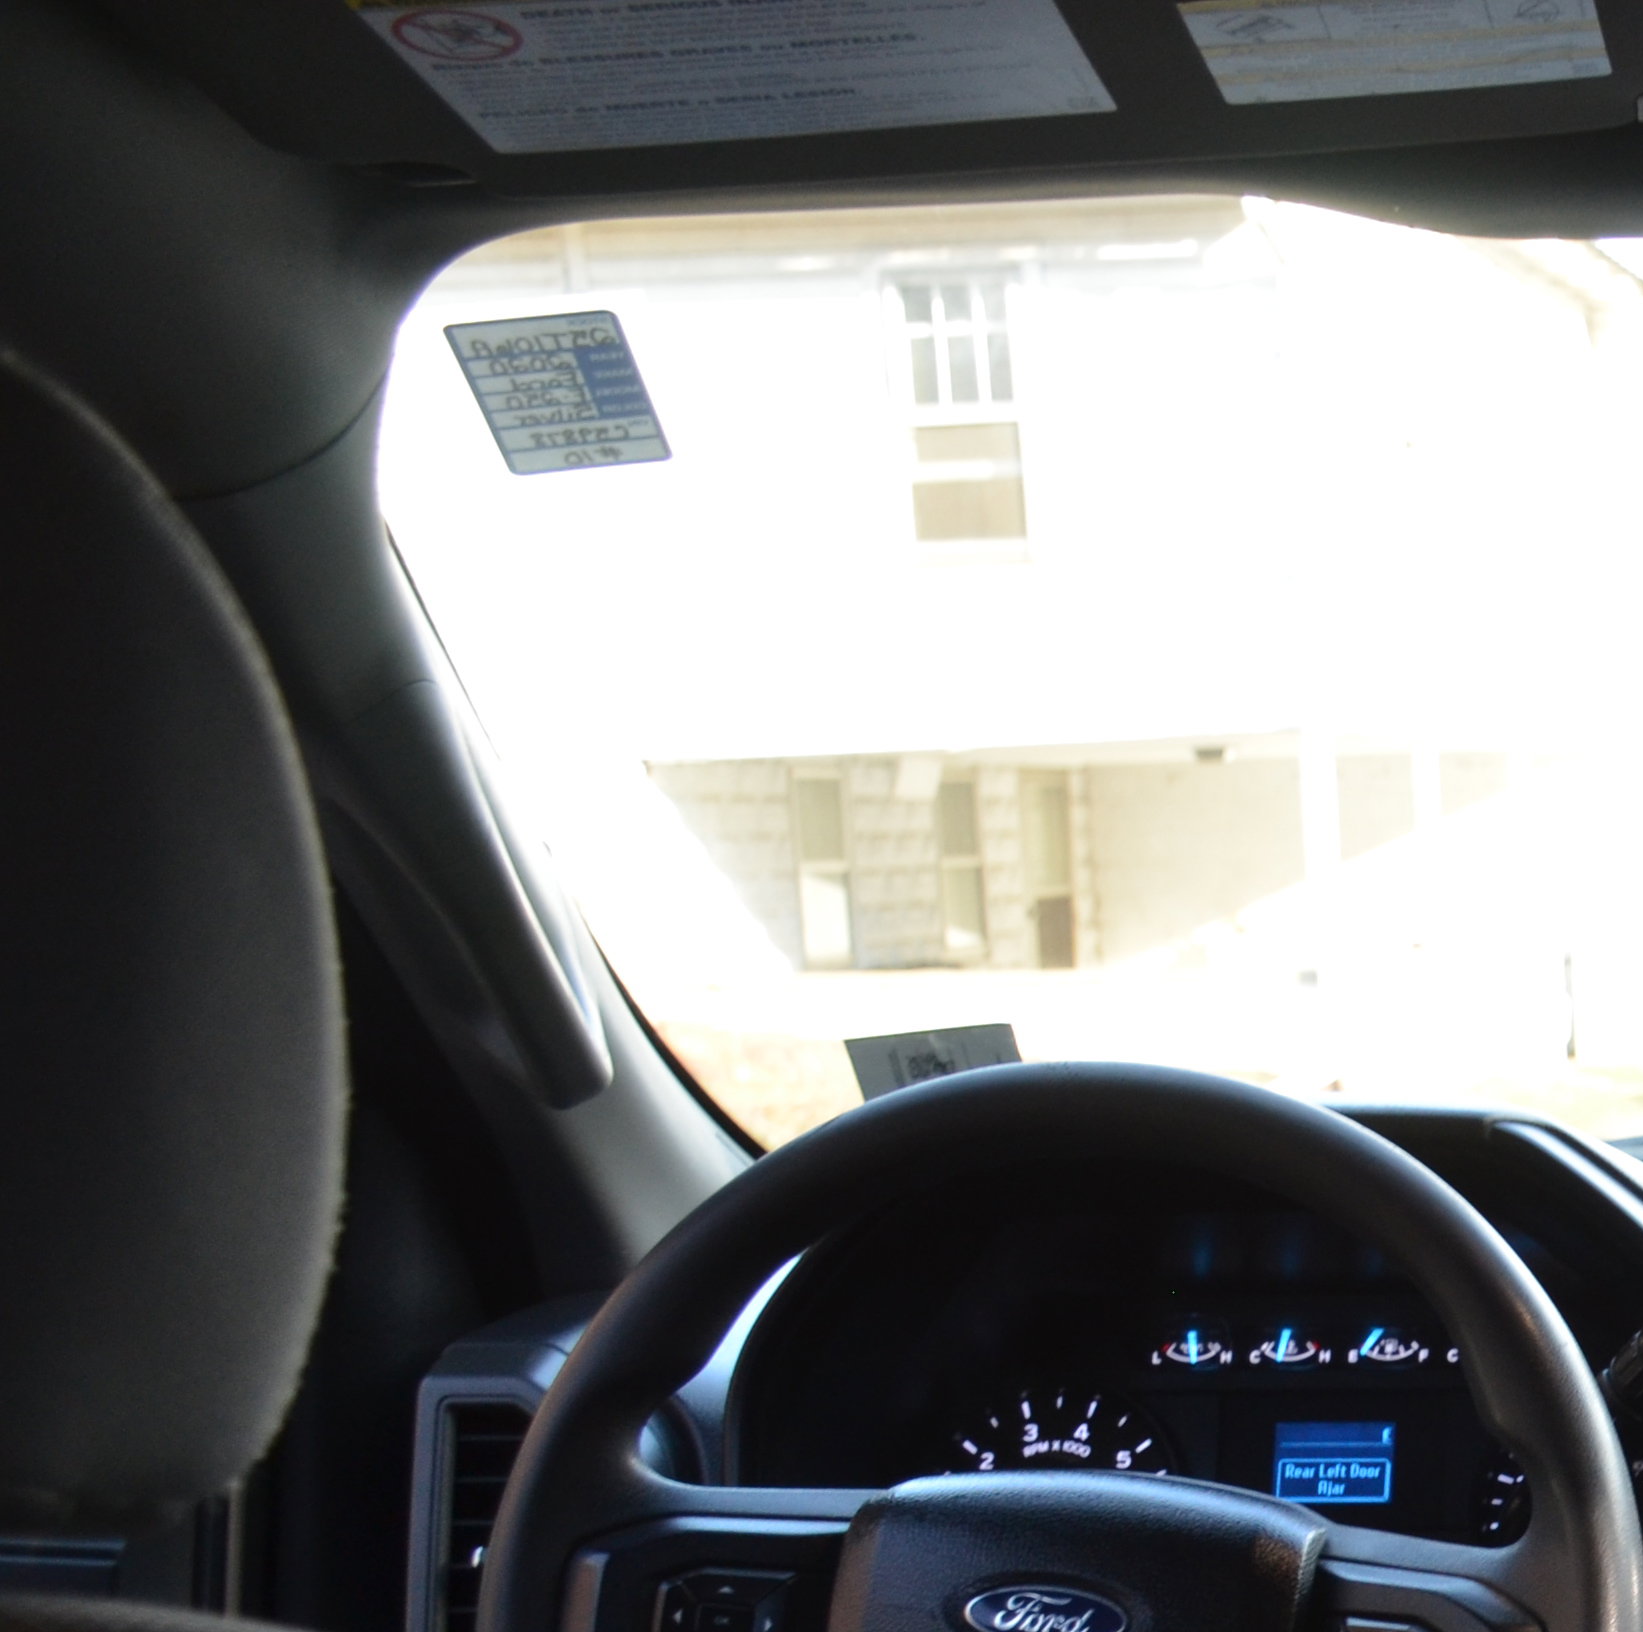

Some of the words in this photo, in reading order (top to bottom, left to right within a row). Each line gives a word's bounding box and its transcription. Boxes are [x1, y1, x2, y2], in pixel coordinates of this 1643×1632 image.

[1152, 1350, 1161, 1364] L
[1220, 1350, 1232, 1364] H
[1250, 1351, 1261, 1365] C
[1318, 1350, 1331, 1364] H
[1022, 1423, 1039, 1442] 3
[1072, 1422, 1090, 1442] 4
[1022, 1440, 1050, 1459] RPM
[1061, 1440, 1092, 1459] 1000
[978, 1451, 996, 1471] 2
[1115, 1450, 1133, 1469] 5
[1284, 1462, 1316, 1479] Rear
[1318, 1462, 1347, 1479] Left
[1349, 1462, 1381, 1479] Door
[1317, 1479, 1346, 1497] Ajar
